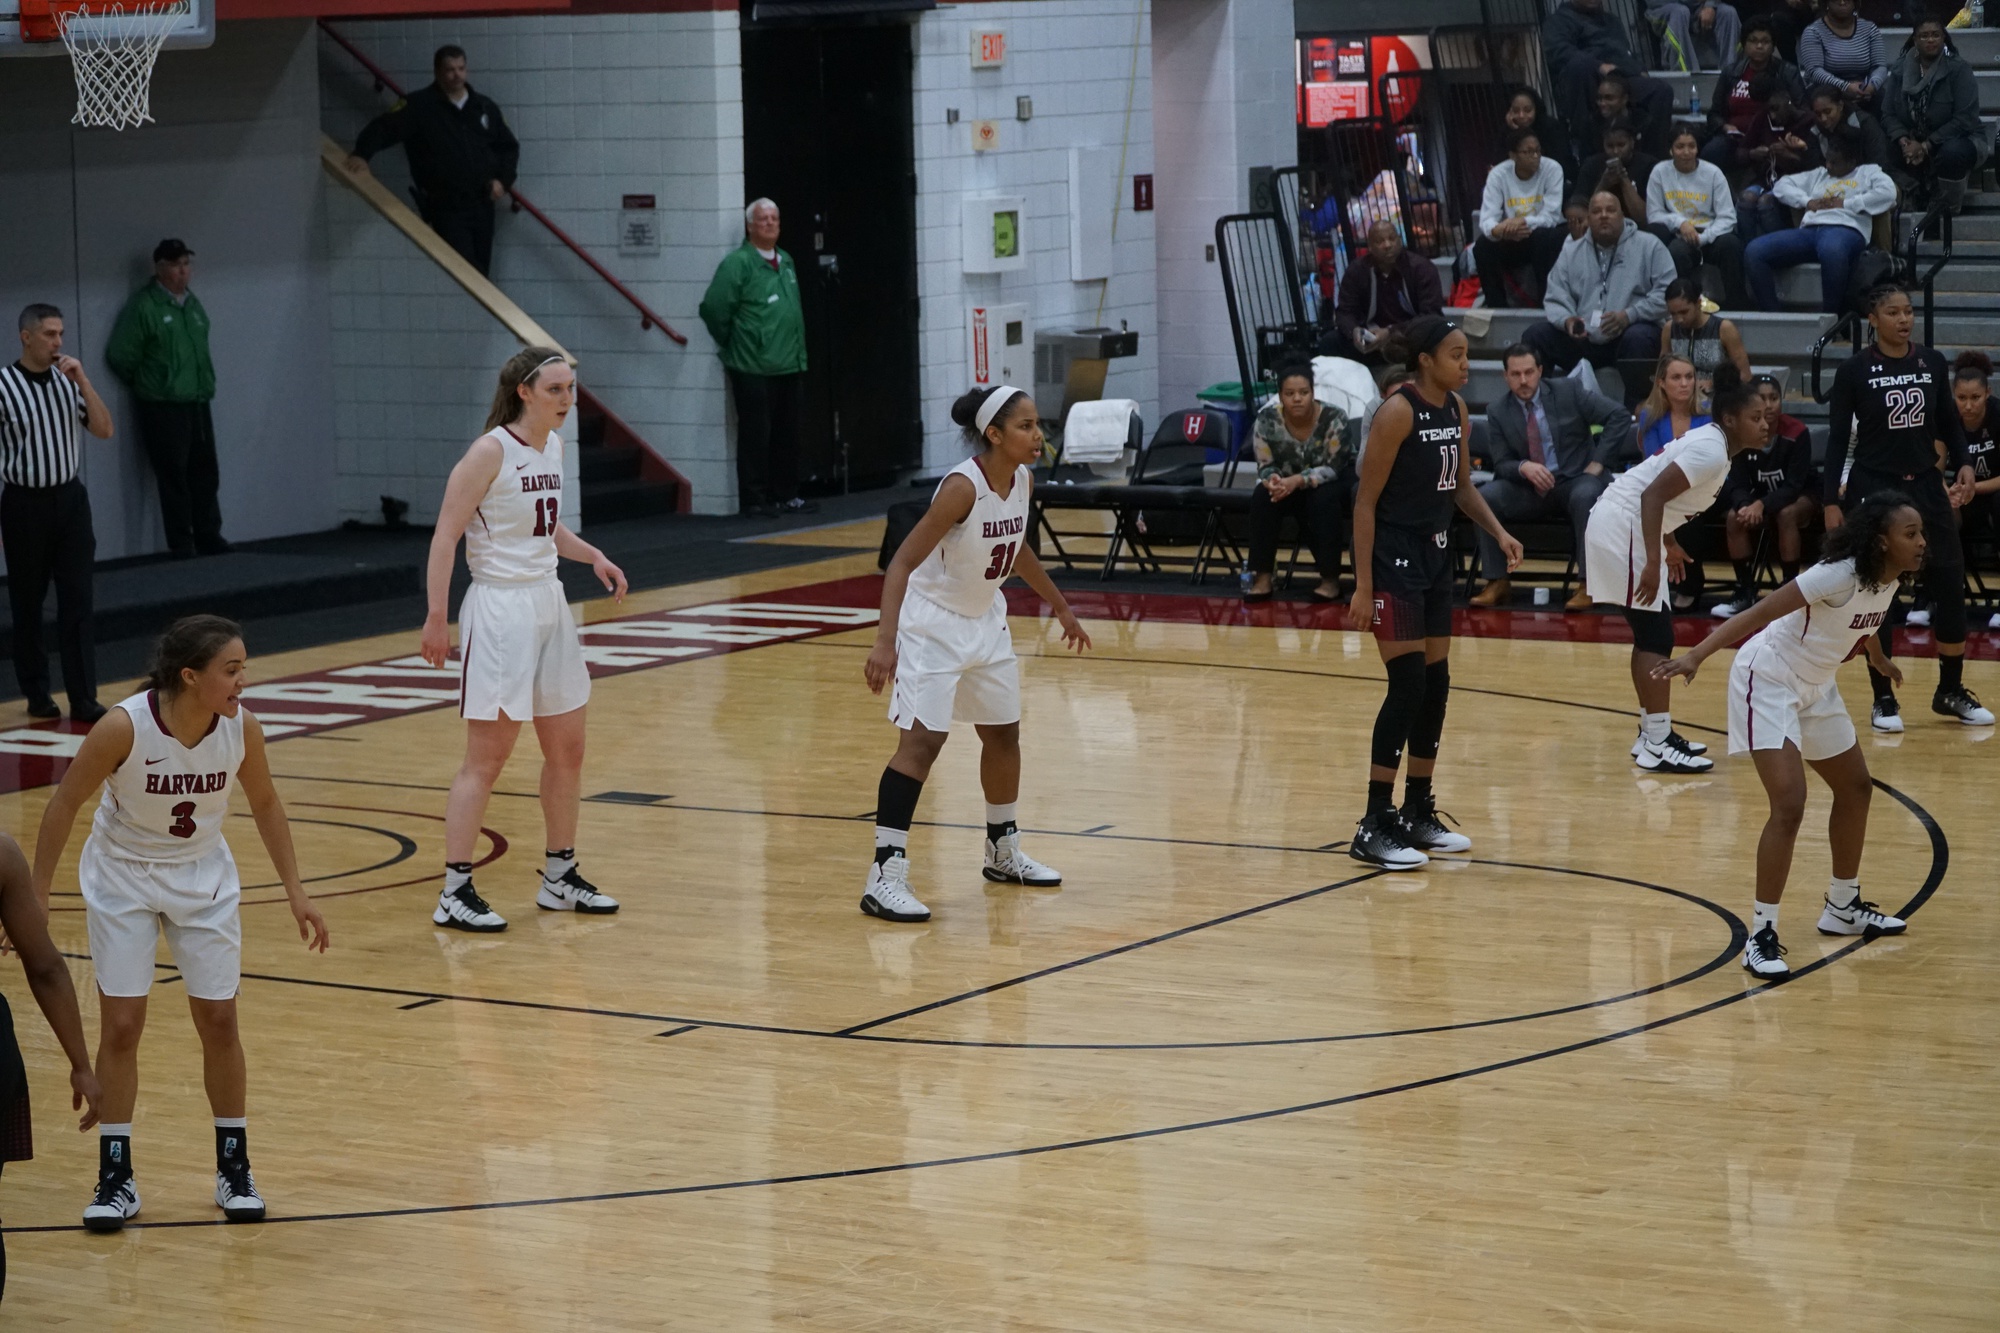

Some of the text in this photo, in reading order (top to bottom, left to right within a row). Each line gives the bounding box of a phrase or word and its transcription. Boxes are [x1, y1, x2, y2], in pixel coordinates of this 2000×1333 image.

[982, 34, 1002, 60] EXIT
[1868, 373, 1932, 389] TEMPLE
[1885, 388, 1926, 430] 22
[1187, 416, 1201, 435] H
[1419, 426, 1462, 442] TEMPL
[1437, 445, 1459, 491] 11
[521, 474, 561, 493] HARVARD
[533, 497, 558, 537] 13
[982, 516, 1023, 538] HARVARD
[984, 541, 1016, 580] 31
[1848, 610, 1887, 630] HARVA
[145, 771, 227, 795] HARVARD
[168, 801, 197, 839] 3
